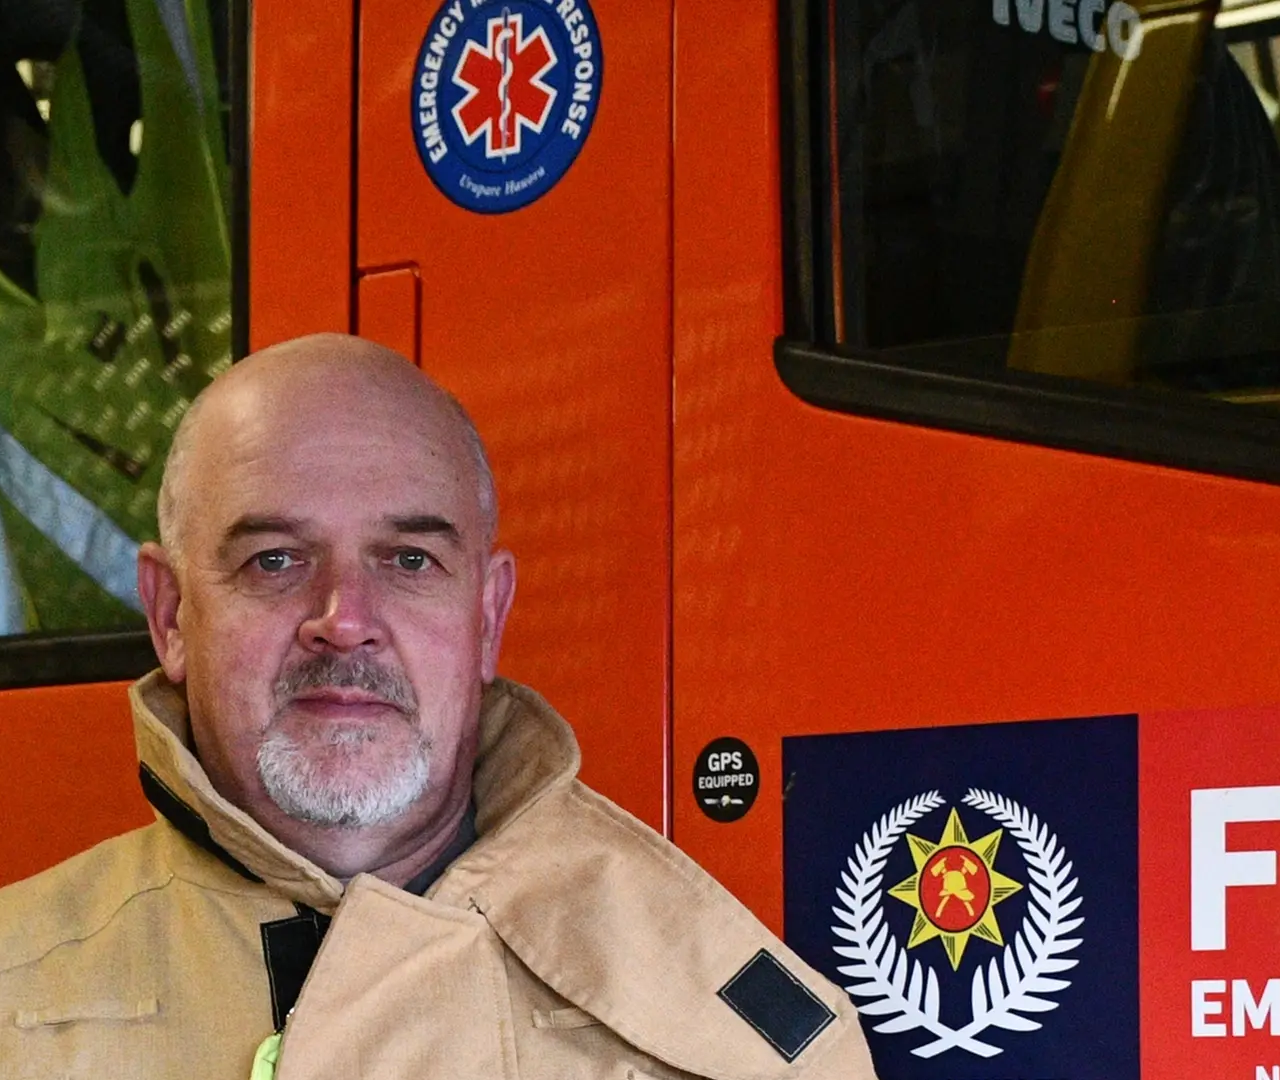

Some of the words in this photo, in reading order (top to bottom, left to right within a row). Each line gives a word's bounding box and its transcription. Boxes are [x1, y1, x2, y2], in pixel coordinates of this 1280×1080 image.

[419, 1, 465, 163] EMERGENCY
[556, 0, 594, 140] RESPONSE
[698, 773, 754, 789] EQUIPPED
[708, 751, 743, 772] GPS
